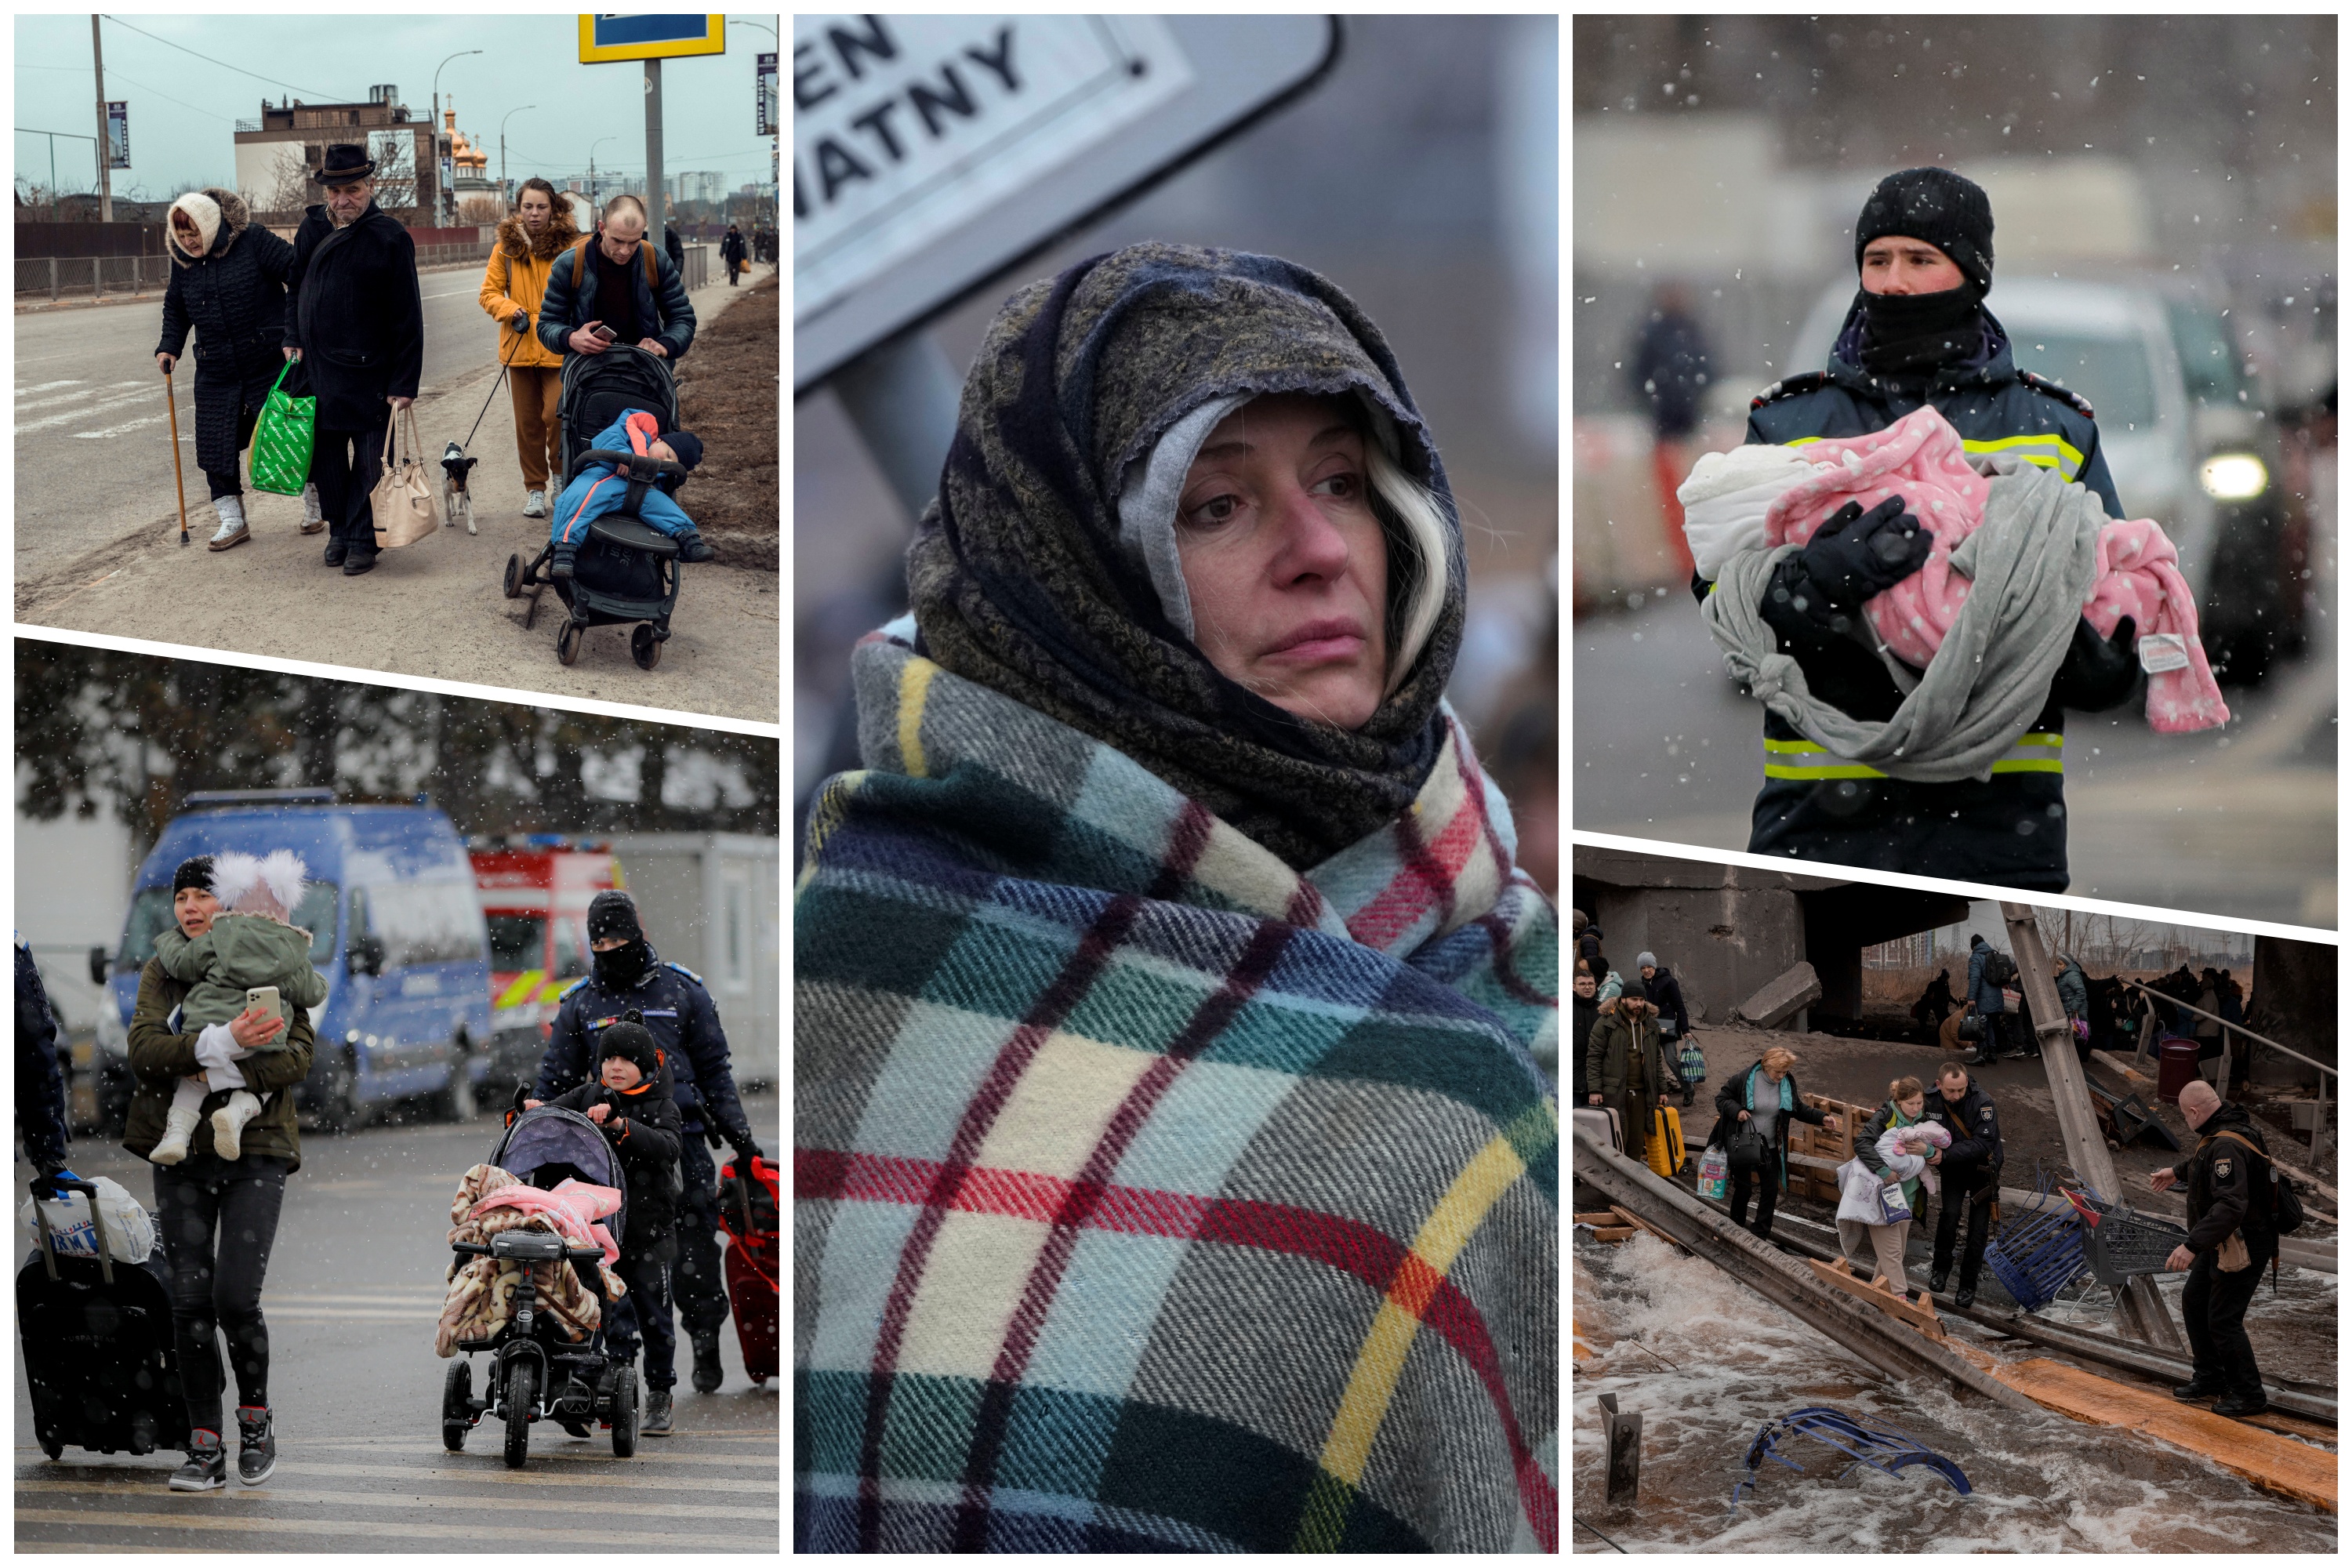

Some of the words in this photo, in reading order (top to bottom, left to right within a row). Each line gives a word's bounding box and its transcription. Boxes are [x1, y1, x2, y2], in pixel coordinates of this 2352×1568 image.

[267, 419, 283, 440] PACKETOFF
[282, 422, 299, 442] PACKETOFF
[270, 441, 286, 463] PACKETOFF
[285, 444, 302, 465] PACKETOFF
[260, 460, 276, 482] PACKETOFF
[275, 463, 292, 485] PACKETOFF
